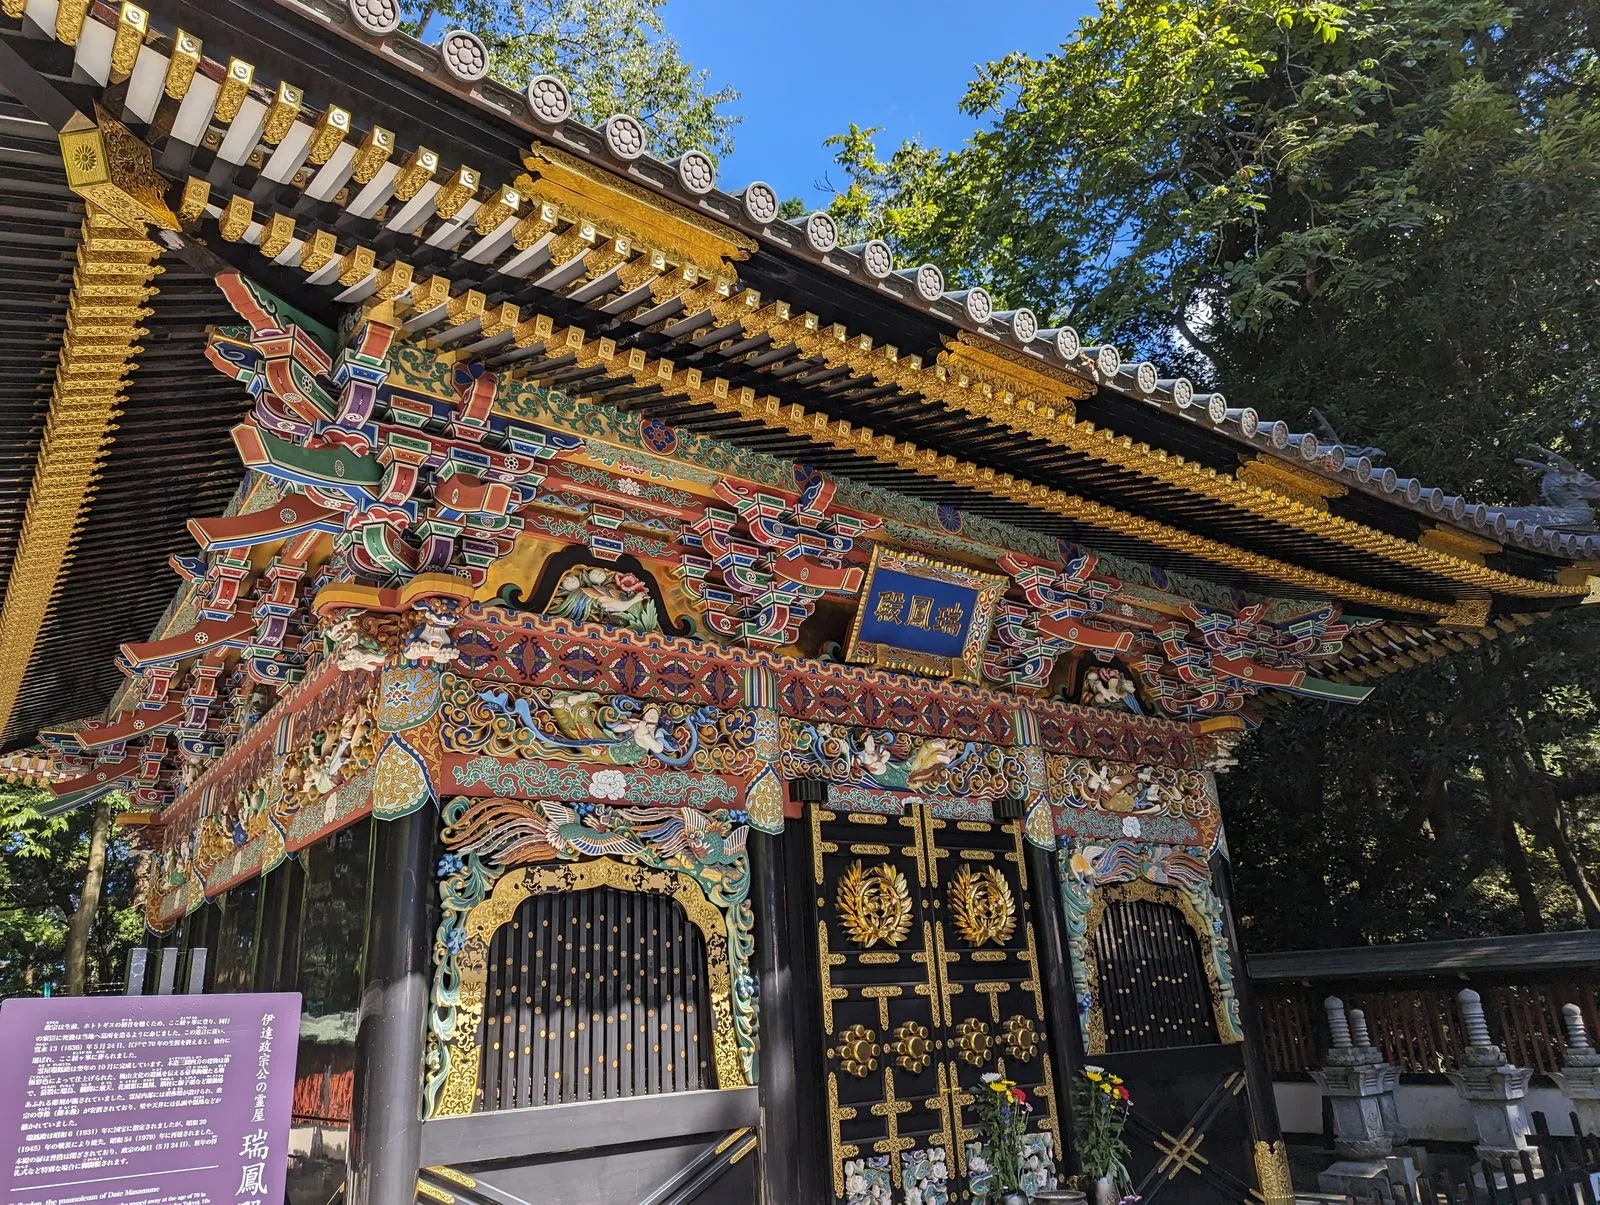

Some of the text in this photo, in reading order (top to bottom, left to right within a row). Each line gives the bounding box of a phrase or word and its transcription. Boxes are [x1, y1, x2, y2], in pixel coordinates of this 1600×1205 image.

[234, 1013, 276, 1205] 伊達政宗公の霊屋 瑞鳳
[20, 1120, 78, 1131] 描かれていました。
[124, 1187, 160, 1196] Masamune
